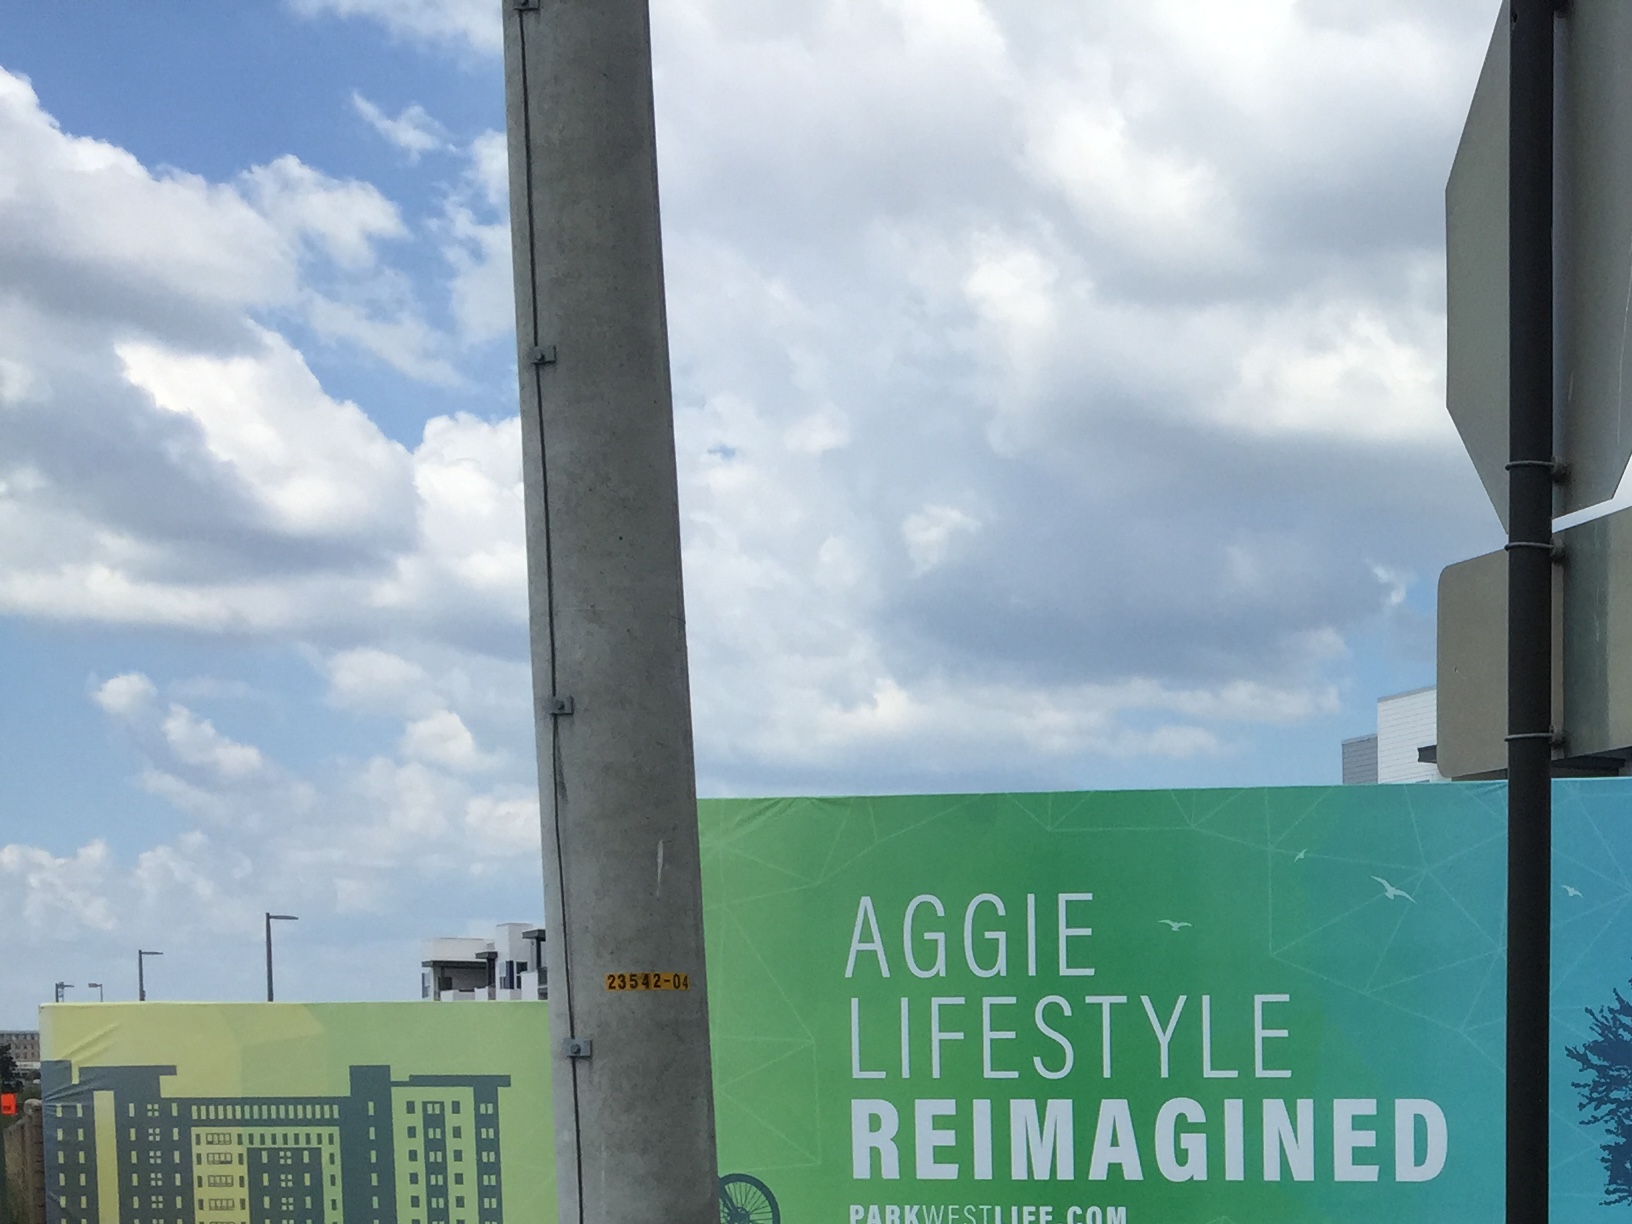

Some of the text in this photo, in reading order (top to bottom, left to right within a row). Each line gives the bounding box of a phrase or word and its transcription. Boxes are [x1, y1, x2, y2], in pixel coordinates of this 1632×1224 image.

[844, 892, 1096, 978] AGGIE
[607, 973, 689, 990] 23542-04
[850, 993, 1293, 1080] LIFESTYLE
[850, 1097, 1449, 1182] REIMAGINED
